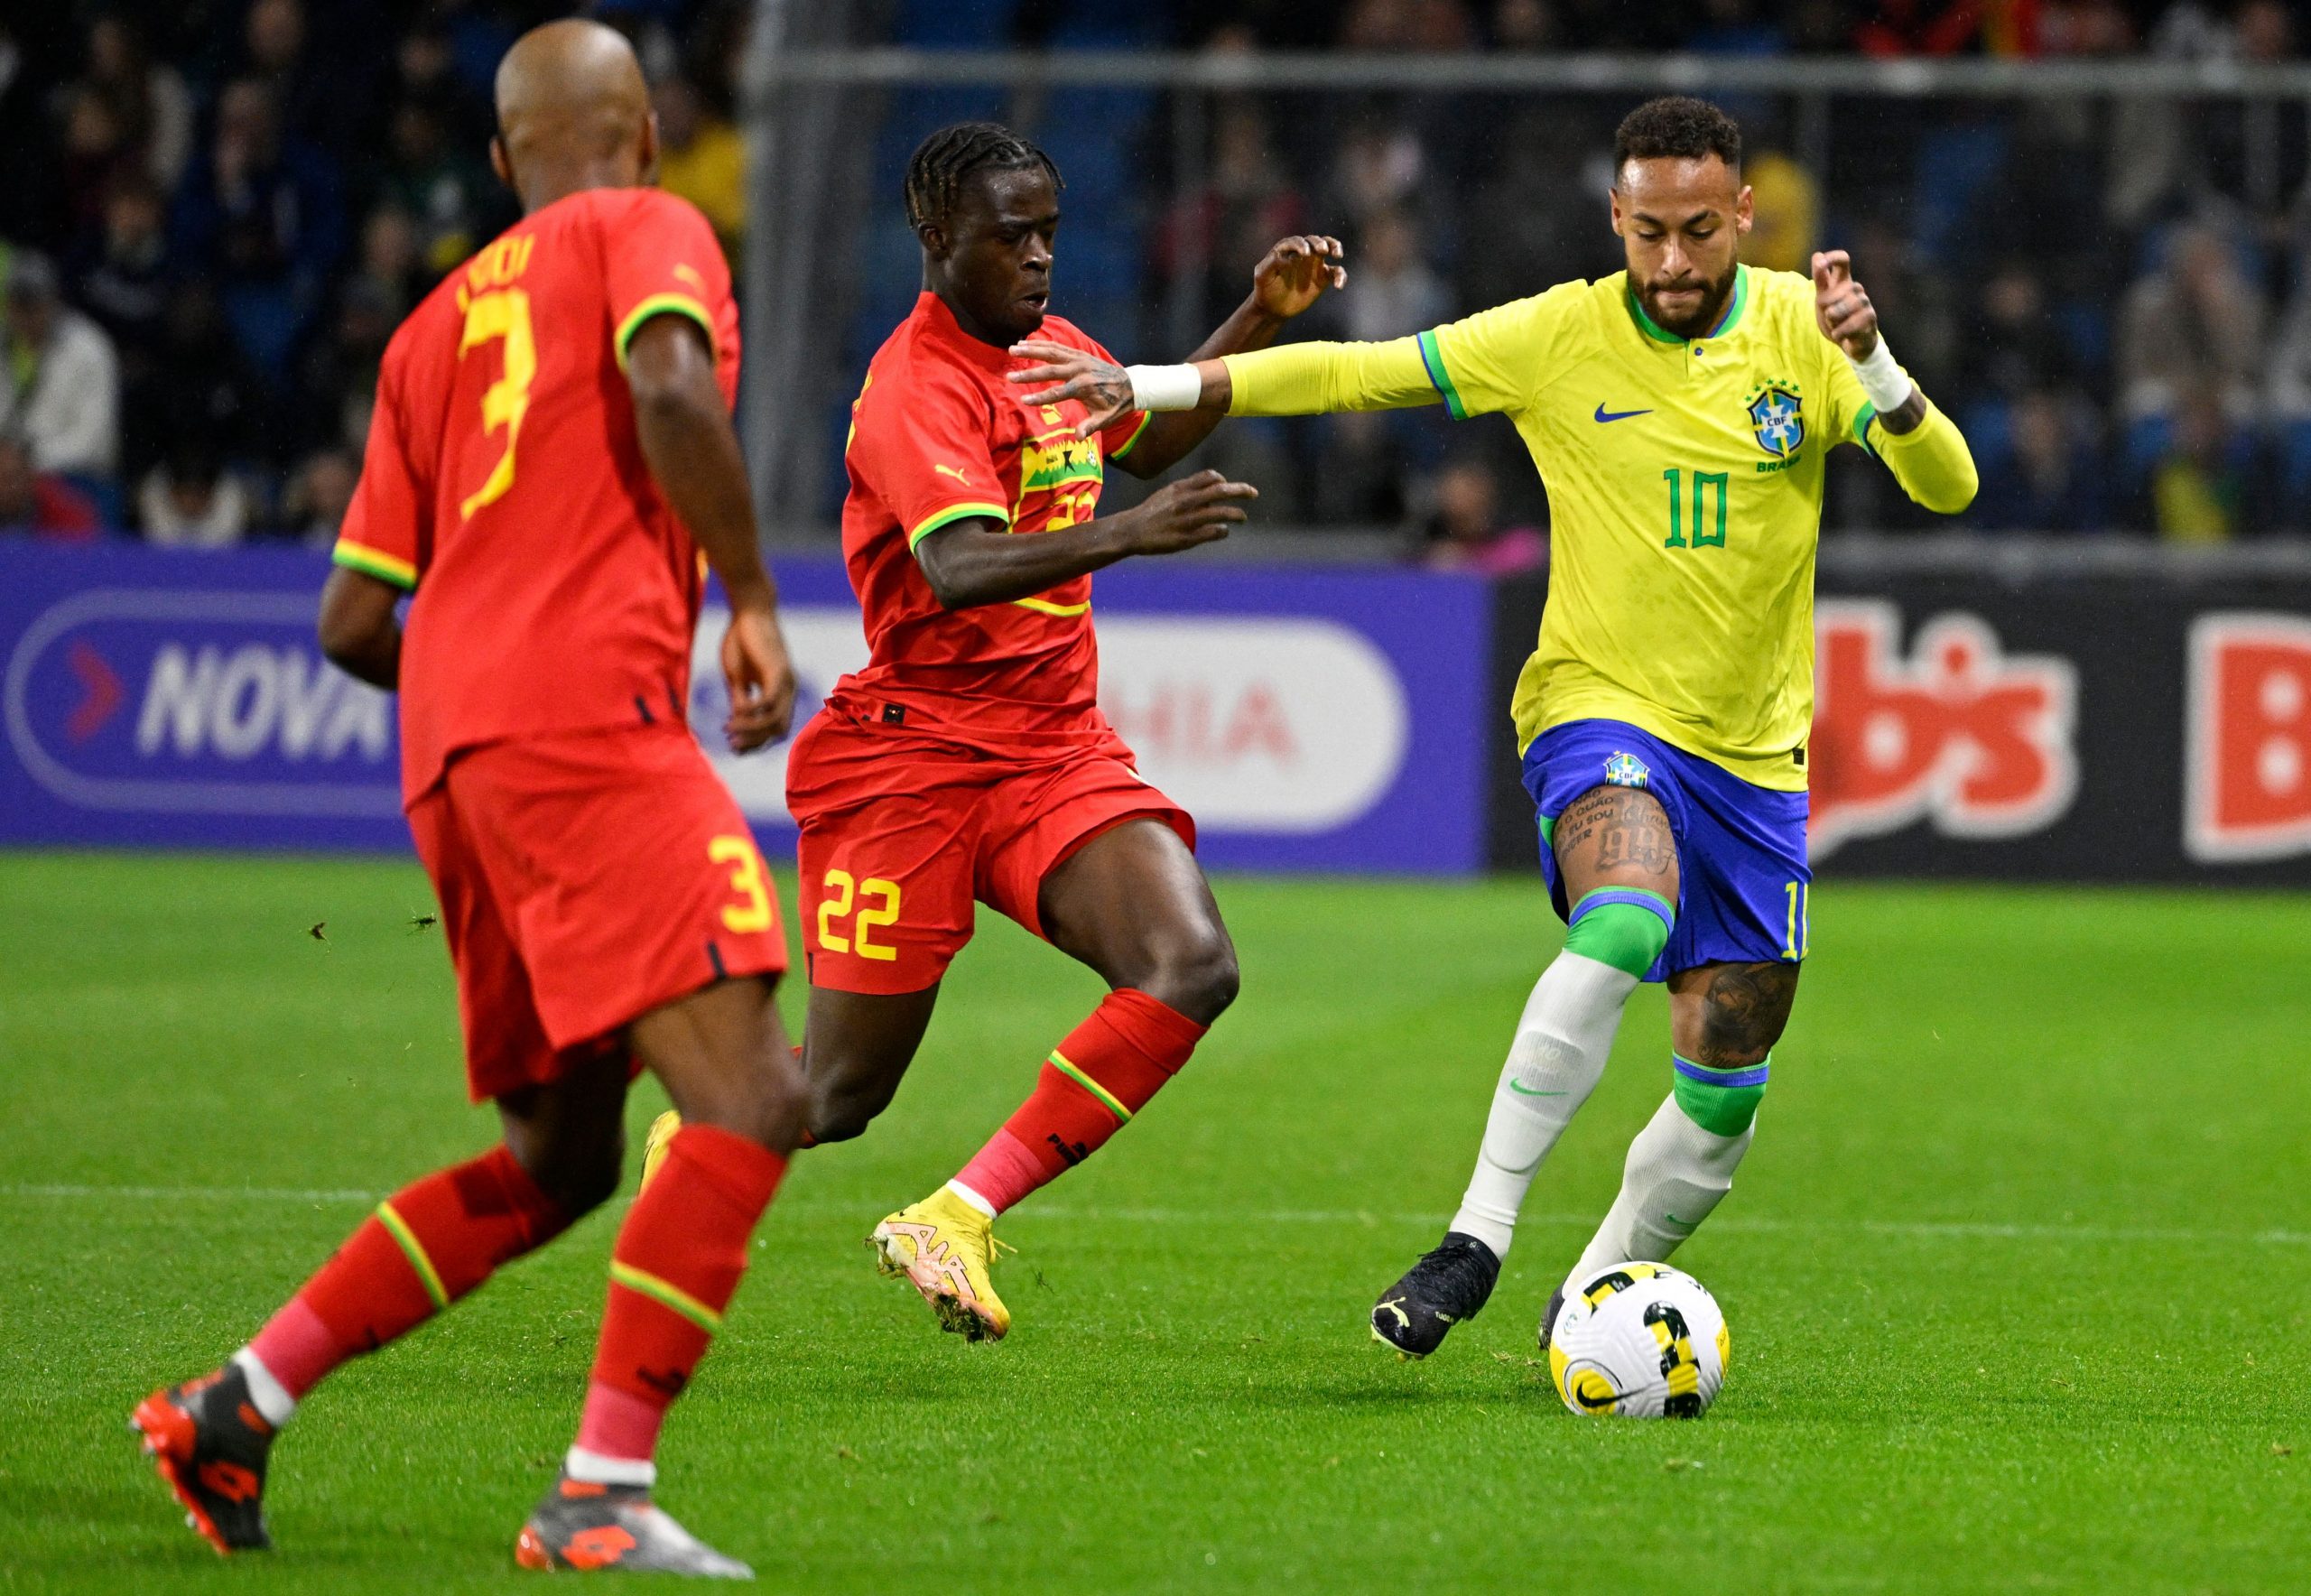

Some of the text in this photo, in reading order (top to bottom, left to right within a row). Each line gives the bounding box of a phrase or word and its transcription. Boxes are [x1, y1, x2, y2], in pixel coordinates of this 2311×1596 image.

[458, 286, 537, 522] 3
[1767, 416, 1787, 427] CBF
[1664, 469, 1728, 549] 10
[708, 834, 772, 933] 3
[817, 868, 901, 961] 22
